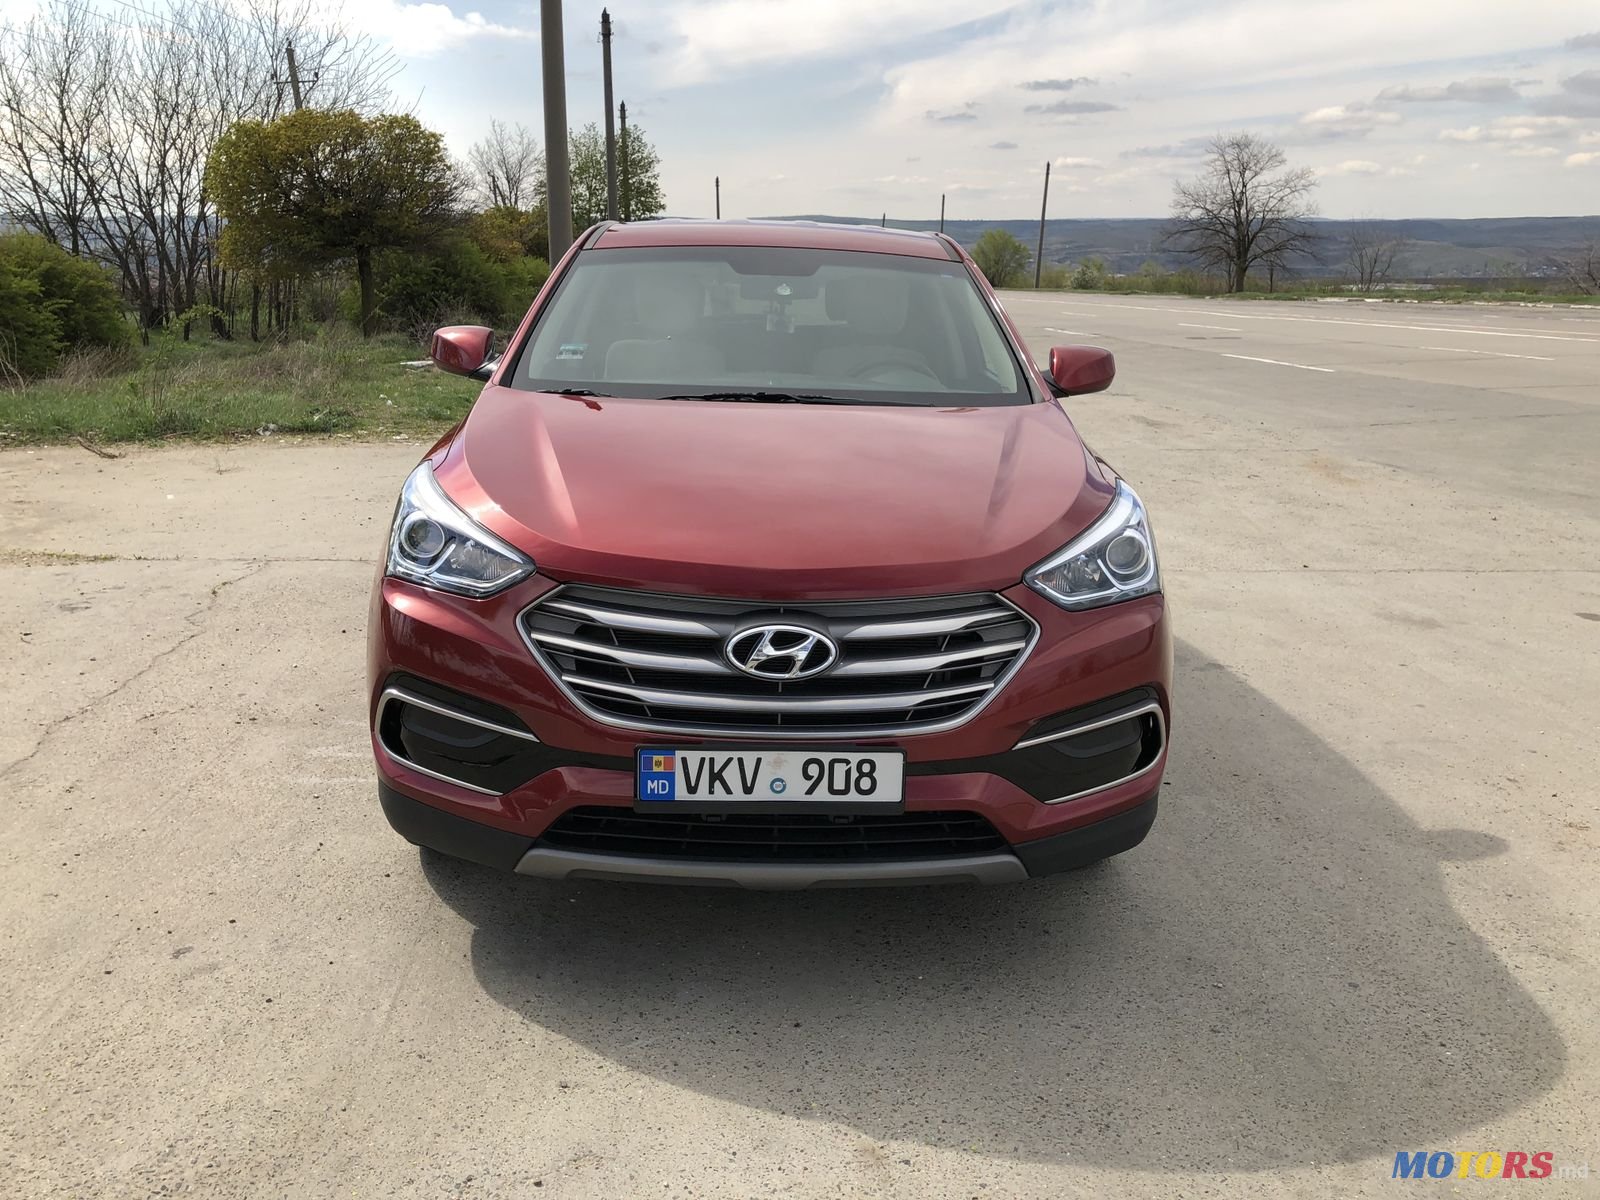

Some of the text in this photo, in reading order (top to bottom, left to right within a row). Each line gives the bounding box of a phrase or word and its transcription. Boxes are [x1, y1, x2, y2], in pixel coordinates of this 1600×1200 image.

[647, 780, 669, 794] MD
[681, 757, 877, 795] VKV 908
